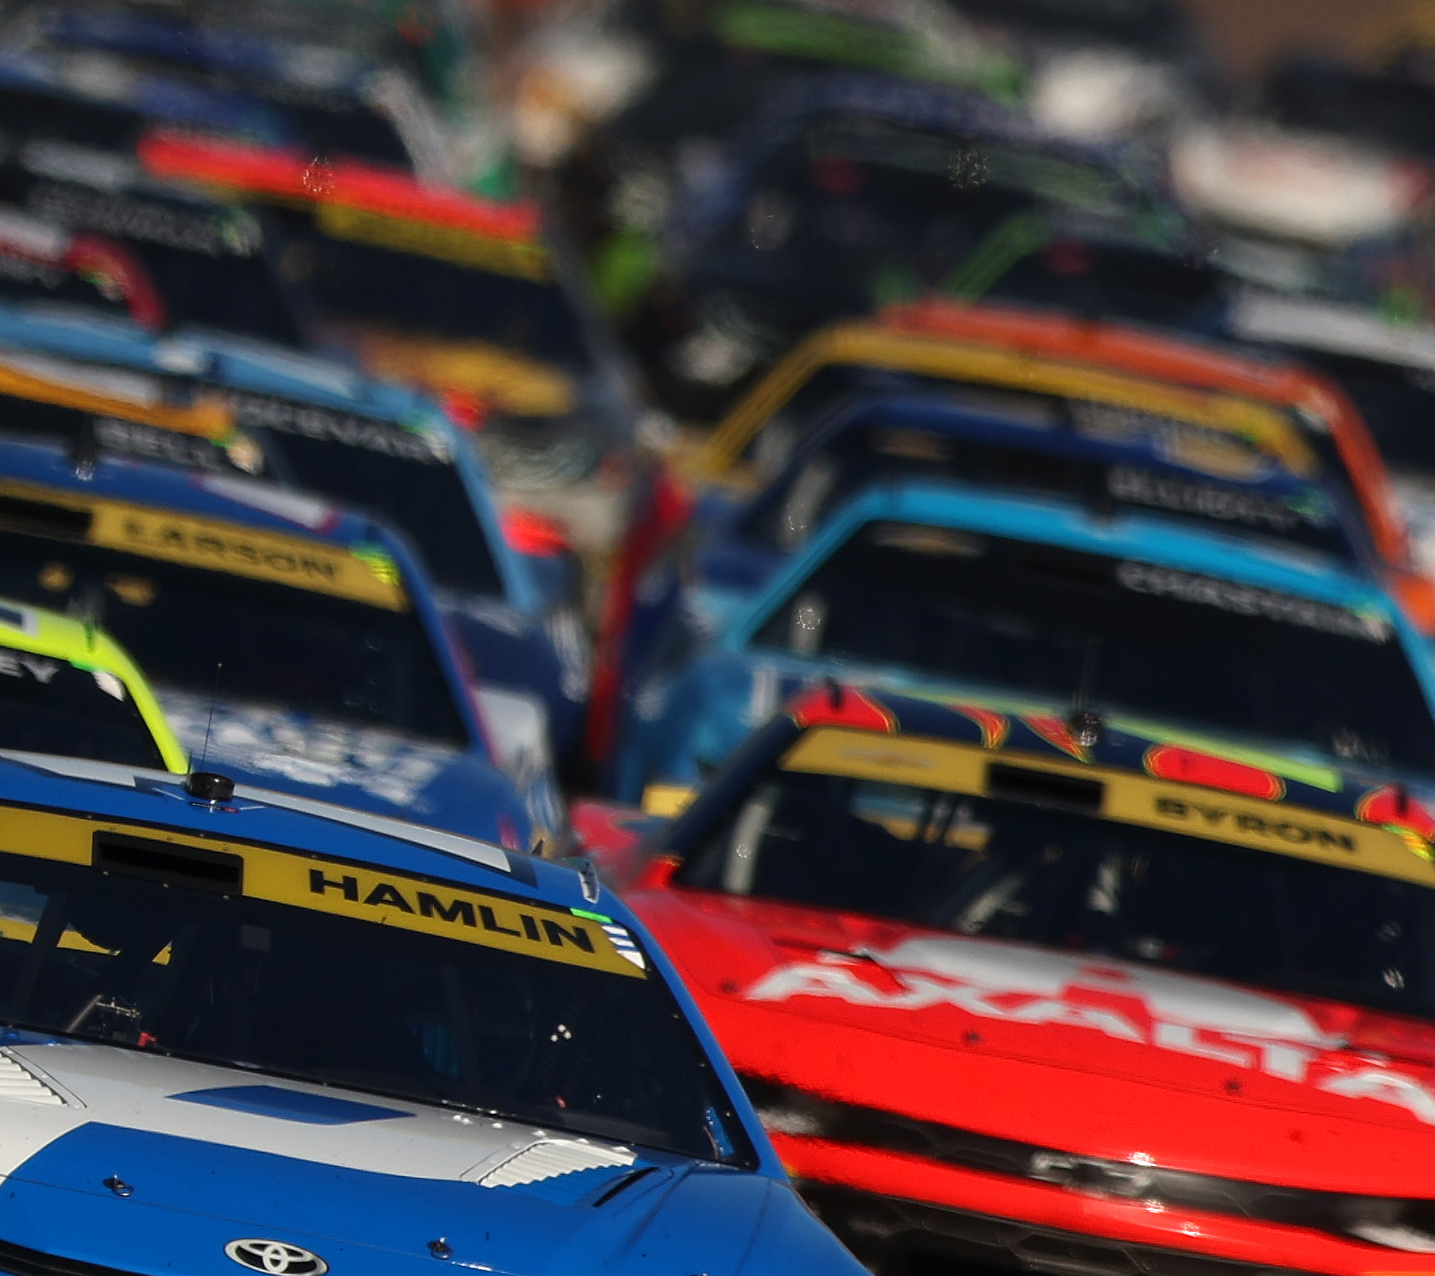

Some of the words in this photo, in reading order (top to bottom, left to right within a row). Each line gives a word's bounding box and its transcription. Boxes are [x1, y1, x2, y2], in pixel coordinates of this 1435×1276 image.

[123, 517, 338, 579] LARSON
[1154, 795, 1357, 856] BYRON
[310, 868, 596, 955] HAMLIN
